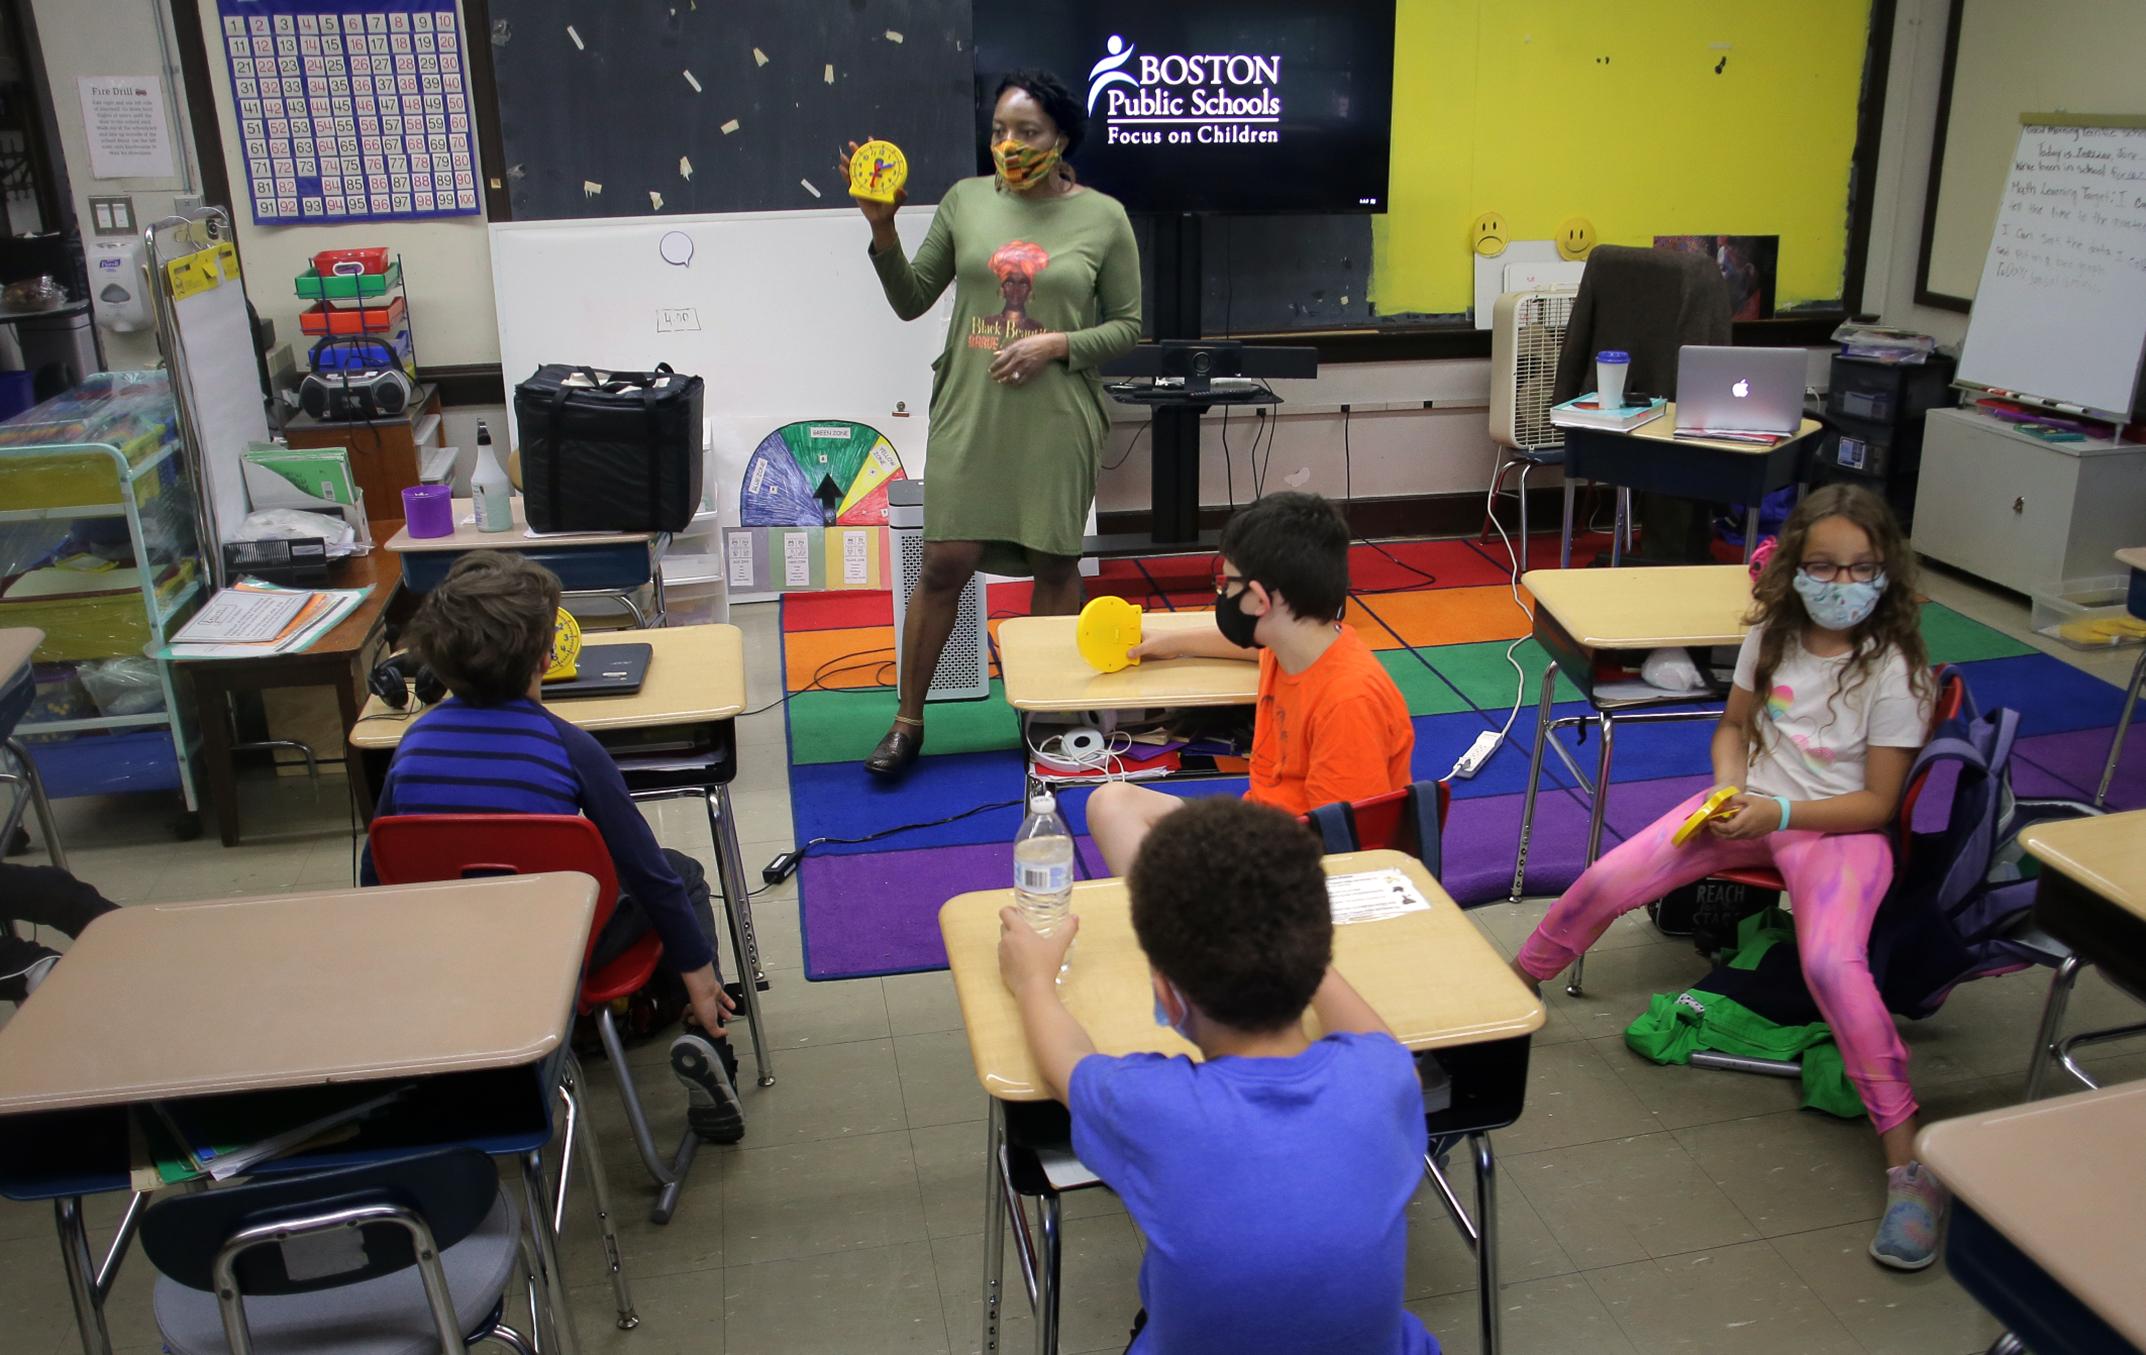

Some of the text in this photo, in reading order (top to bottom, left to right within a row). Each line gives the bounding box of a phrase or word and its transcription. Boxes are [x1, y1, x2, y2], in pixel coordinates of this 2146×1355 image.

[232, 15, 451, 31] 1 2 3 4 5 6 7 8 9 10
[234, 36, 455, 52] 11 12 13 14 15 16 17 18 19 20
[237, 56, 457, 74] 21 22 23 24 25 26 27 28 29 30
[1140, 55, 1280, 85] BOSTON
[113, 88, 133, 96] Drill
[240, 77, 460, 93] 31 32 33 34 35 36 37 38 39 40
[244, 97, 464, 114] 41 42 43 44 45 46 47 48 49 50
[1108, 88, 1279, 116] Public Schools
[246, 117, 466, 134] 51 52 53 54 55 56 57 58 59 60
[1108, 125, 1278, 144] Focus on Children
[250, 136, 466, 154] 61 62 63 64 65 66 67 68 69 70
[254, 155, 469, 174] 71 72 73 74 75 76 77 78 79 80
[257, 174, 471, 193] 81 82 84 85 86 87 88 89 90
[2012, 181, 2037, 195] Math
[2040, 183, 2078, 200] Learning
[260, 193, 474, 213] 91 92 93 94 95 96 97 98 99 100
[972, 316, 1000, 335] Black
[1696, 885, 1744, 903] REACH
